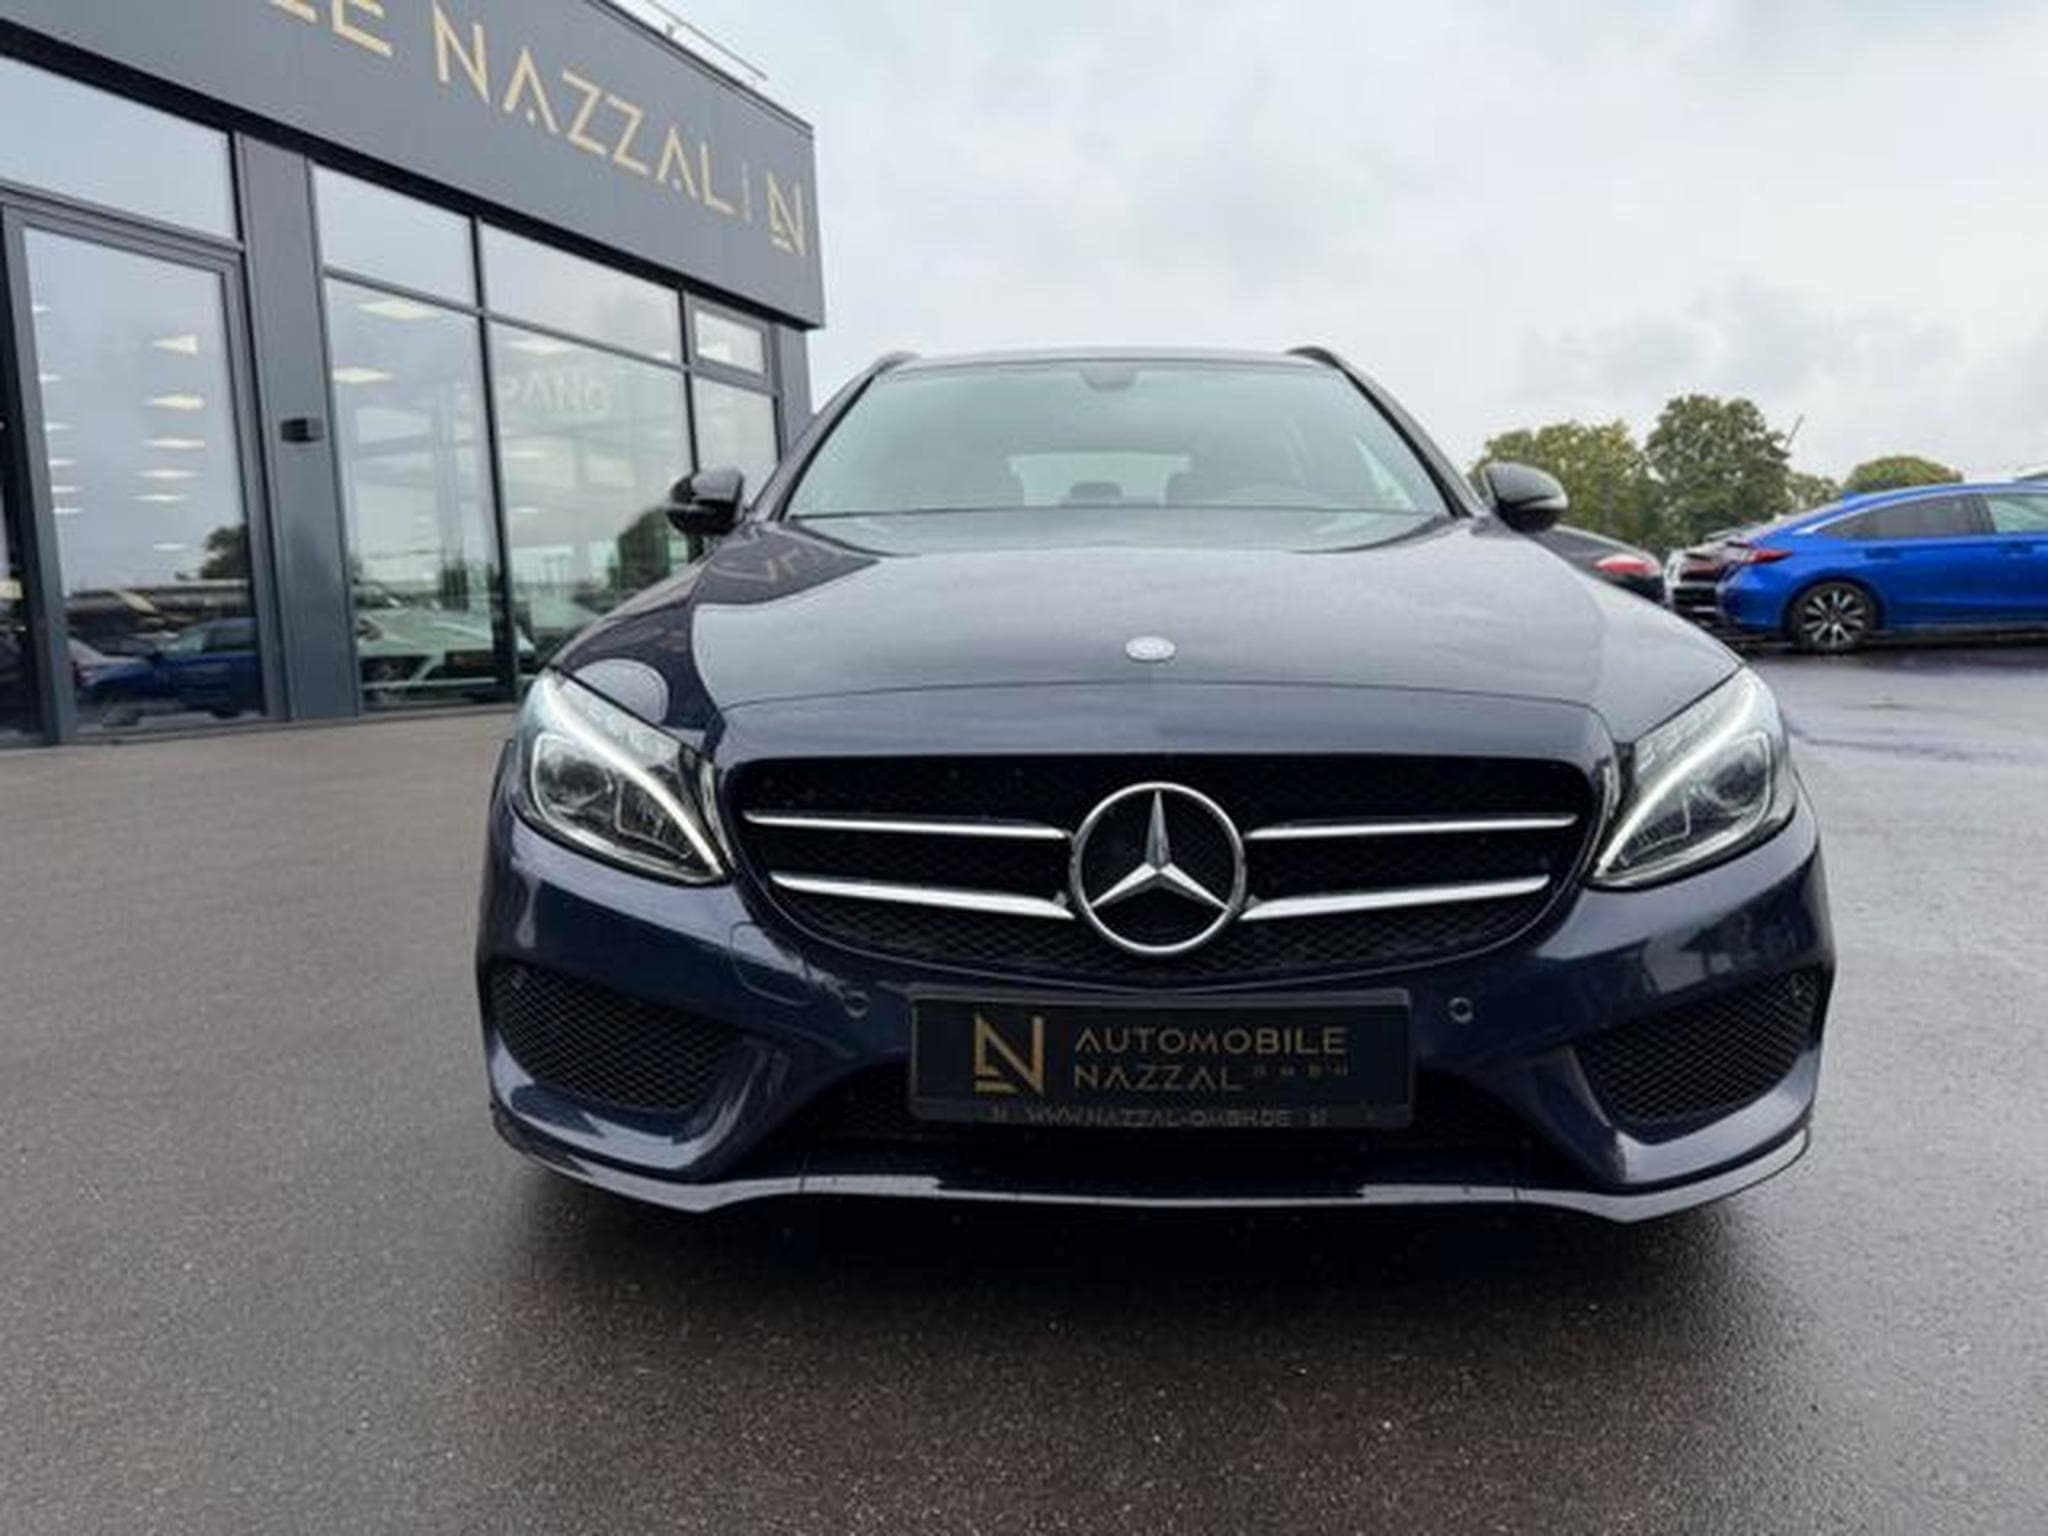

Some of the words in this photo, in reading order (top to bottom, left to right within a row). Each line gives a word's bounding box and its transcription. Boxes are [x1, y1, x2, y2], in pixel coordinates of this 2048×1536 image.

[431, 0, 736, 215] NAZZAL
[1074, 1026, 1348, 1056] AUTOMOBILE
[1074, 1064, 1244, 1092] NAZZAL
